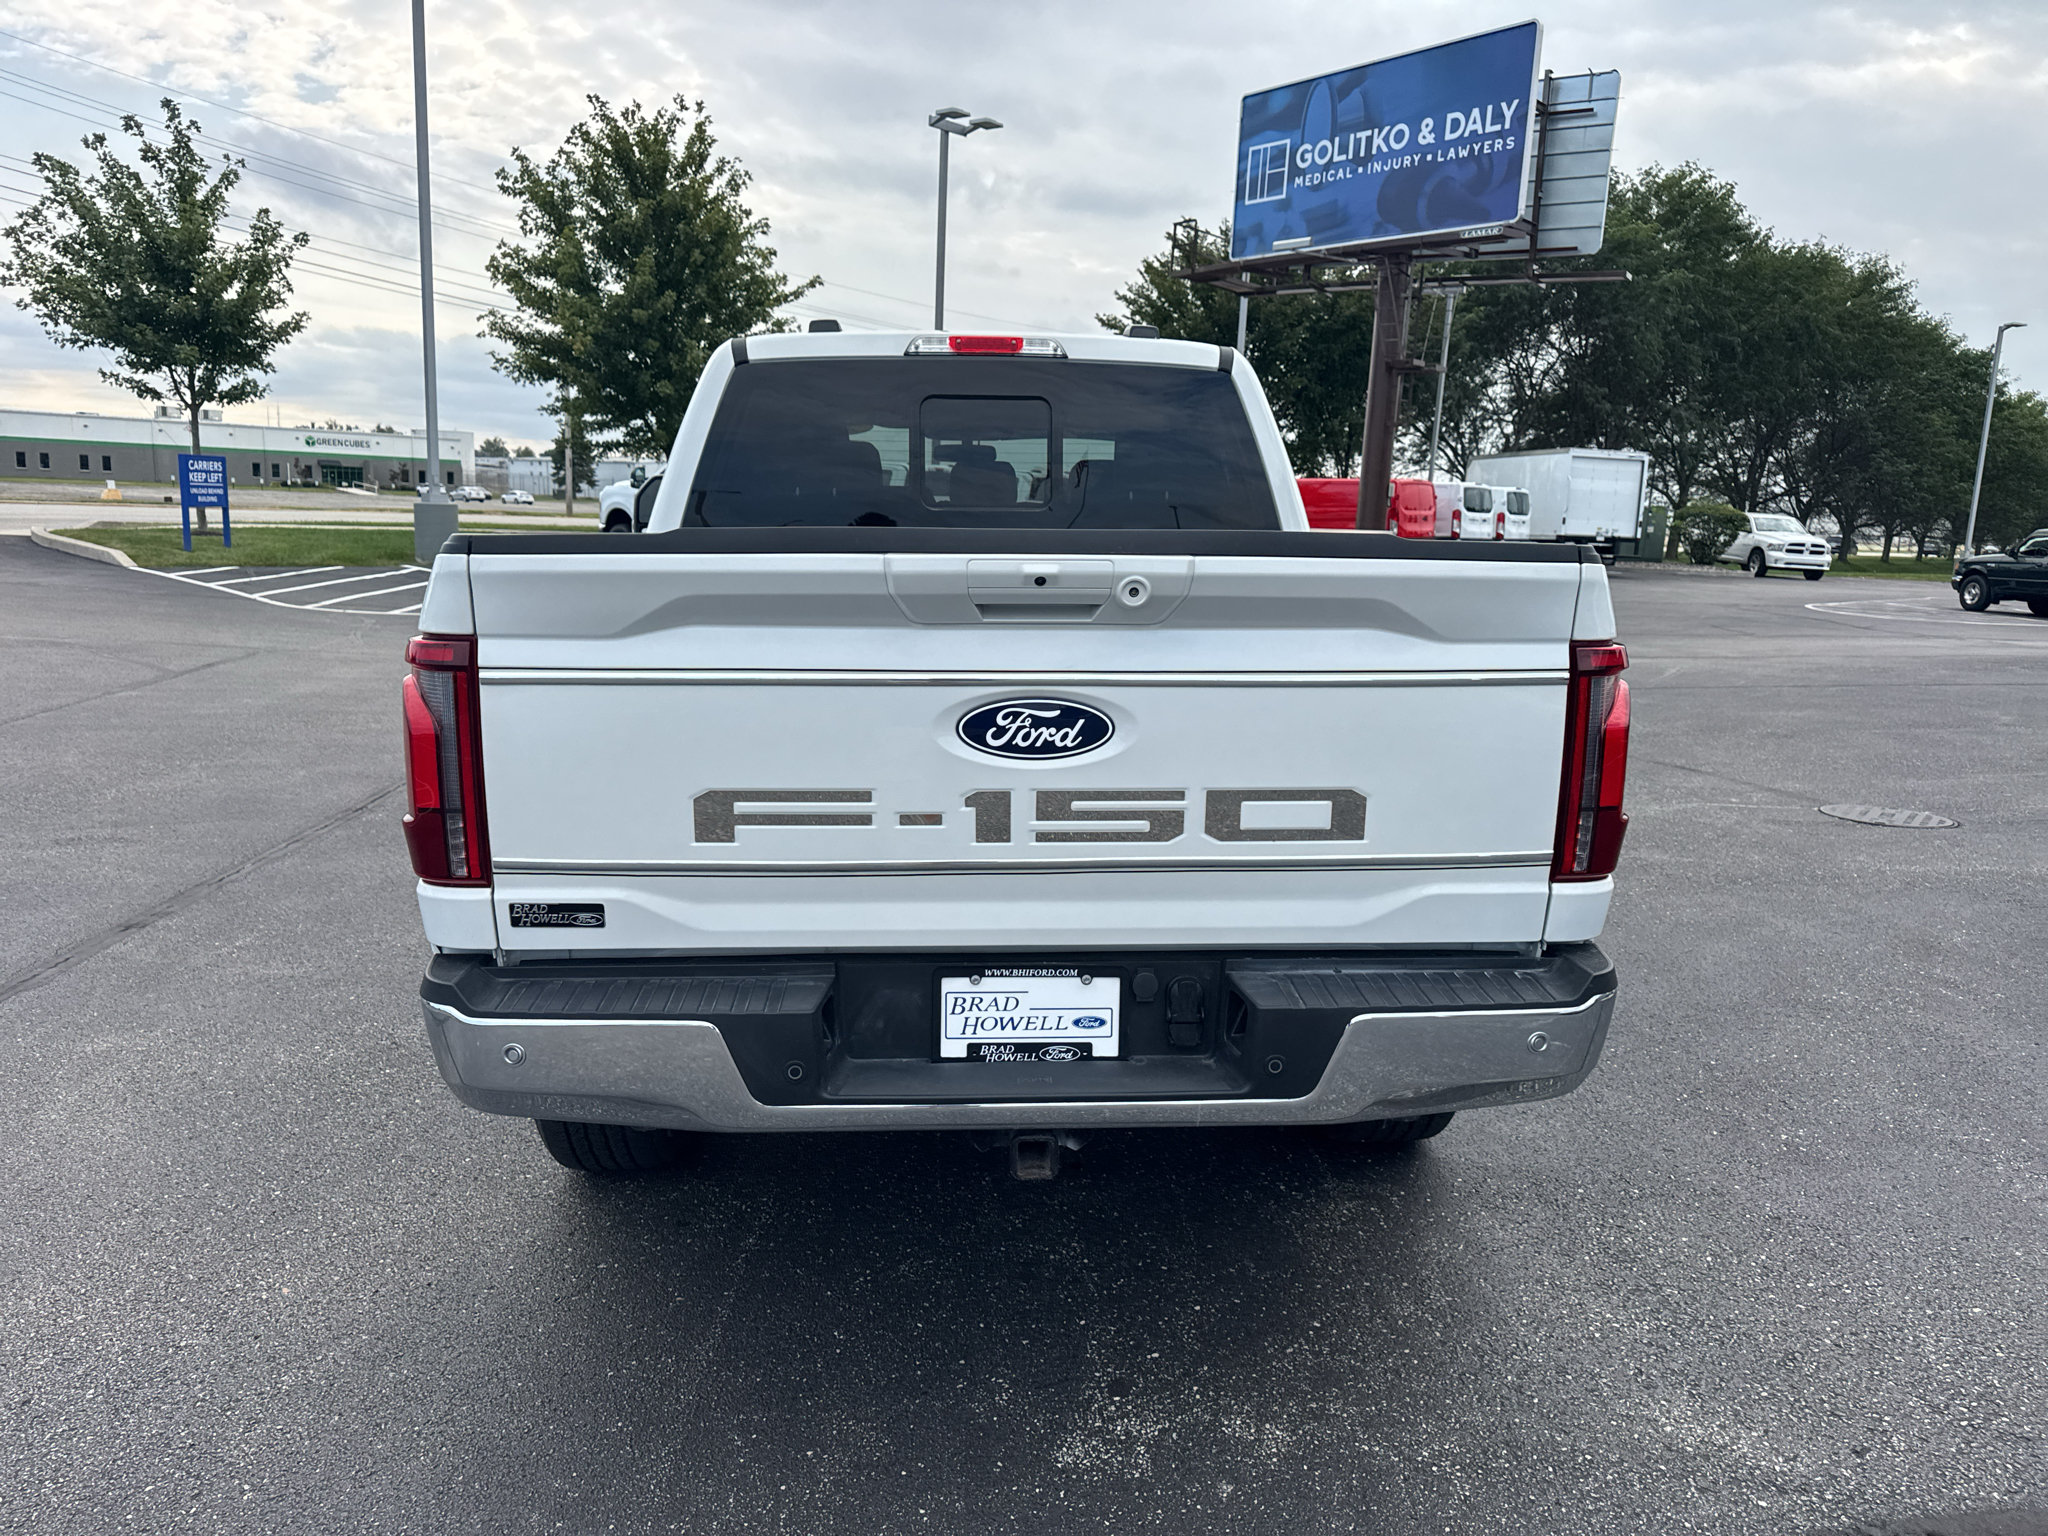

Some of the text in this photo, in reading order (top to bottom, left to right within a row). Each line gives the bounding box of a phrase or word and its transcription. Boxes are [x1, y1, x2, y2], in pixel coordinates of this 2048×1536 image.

[1295, 99, 1520, 169] GOLITKO & DALY
[1294, 136, 1516, 189] MEDICAL INJURY LAWYERS
[188, 460, 223, 471] CARRIERS
[189, 471, 223, 483] KEEP LEFT
[986, 706, 1086, 751] Ford
[692, 788, 1368, 844] F-150
[512, 904, 548, 917] BRAD
[519, 913, 570, 926] HOWELL
[984, 968, 1078, 977] WWW.BHIFORD.COM
[949, 996, 1020, 1016] BRAD
[960, 1015, 1069, 1036] HOWELL
[979, 1045, 1015, 1056] BRAD
[986, 1052, 1039, 1063] HOWELL
